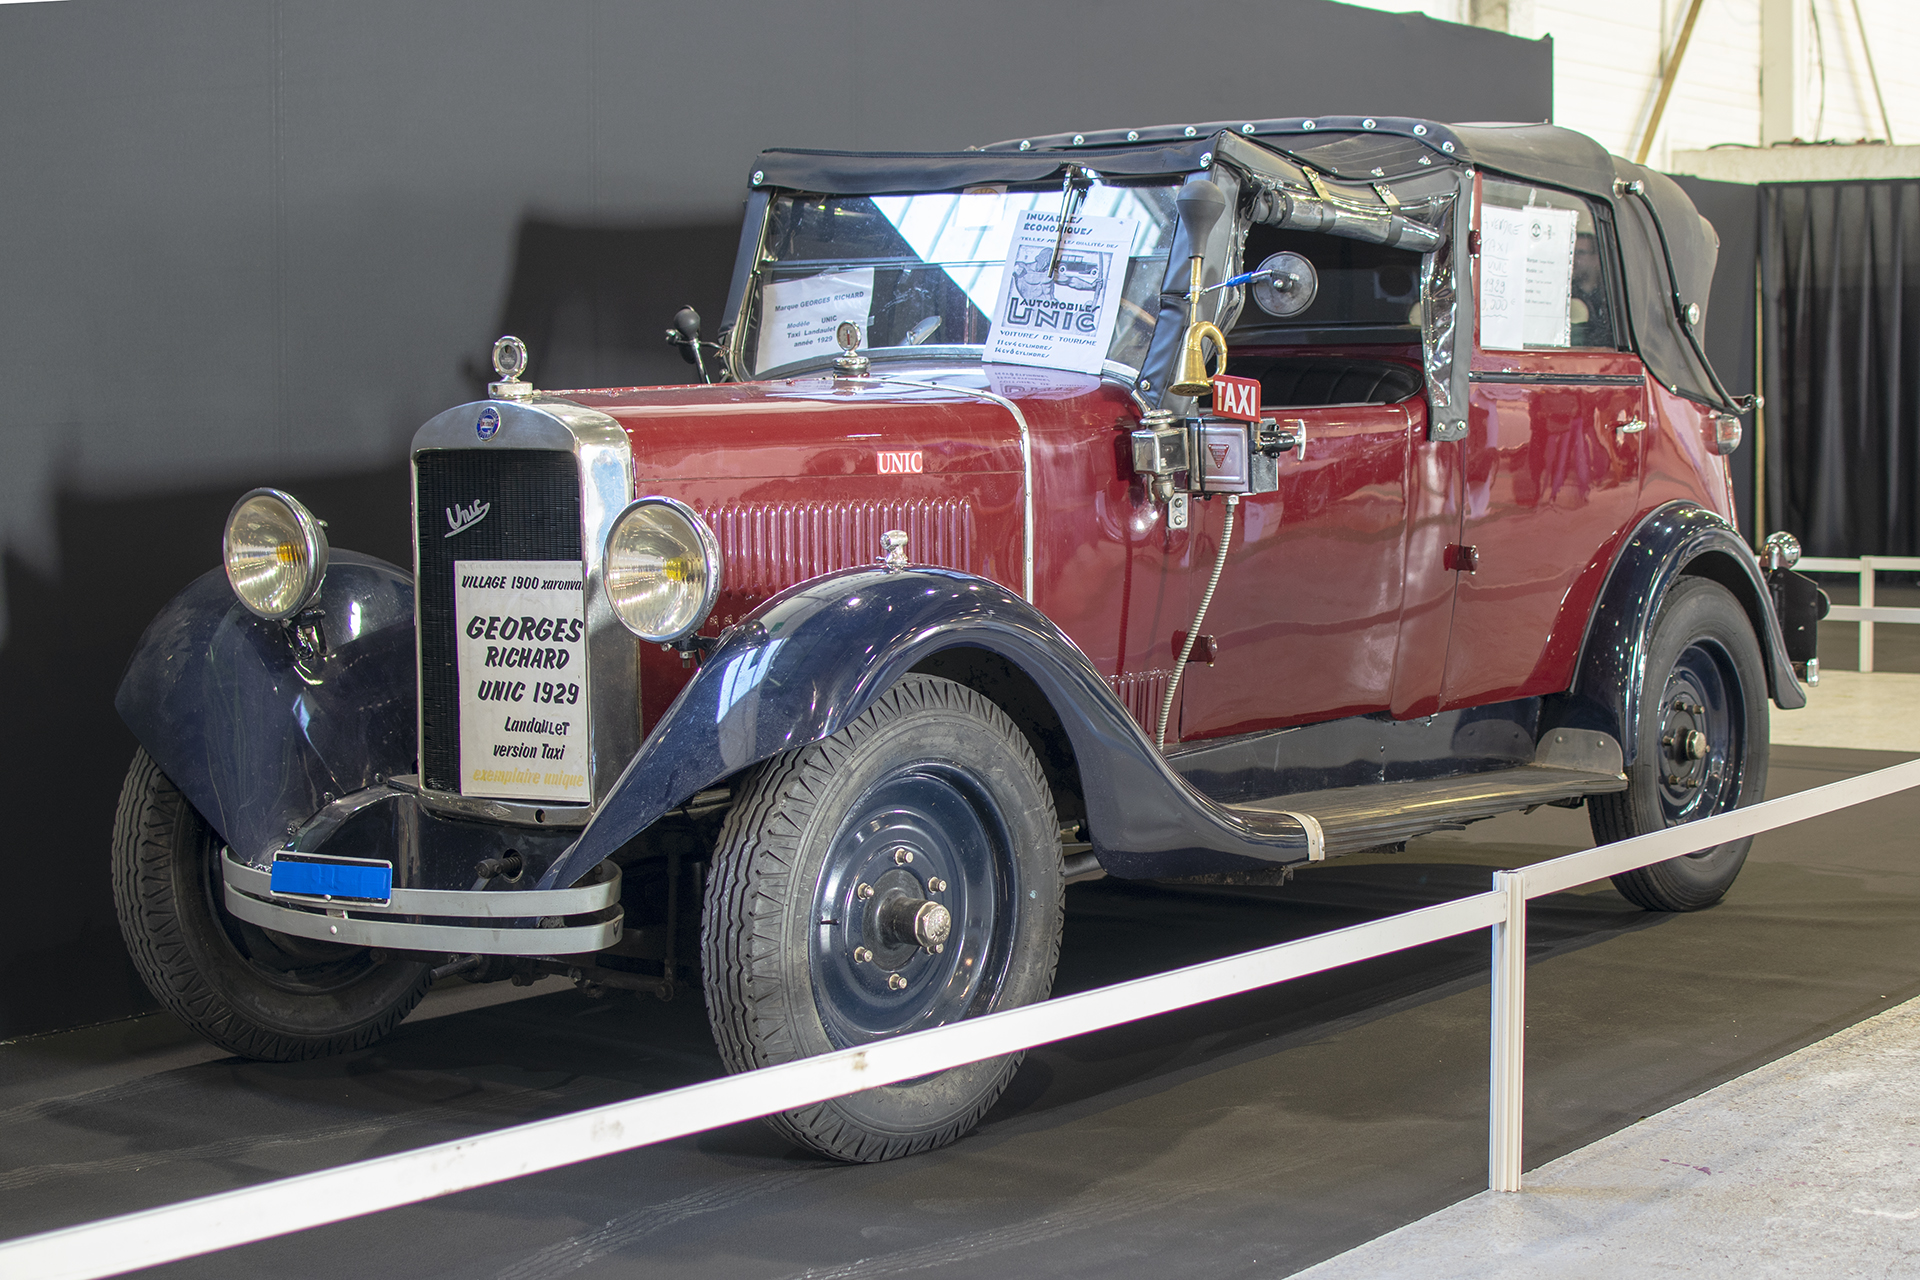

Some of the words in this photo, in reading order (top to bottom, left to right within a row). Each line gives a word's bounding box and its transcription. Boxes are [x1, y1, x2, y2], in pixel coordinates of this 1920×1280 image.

[775, 303, 799, 312] Marque
[800, 297, 831, 308] GEORGES
[834, 291, 864, 301] RICHARD
[1020, 299, 1100, 313] AUTOMOBILES
[786, 320, 810, 329] Modèle
[821, 315, 838, 324] UNIC
[1007, 297, 1096, 333] UNIC
[787, 331, 801, 339] Taxi
[803, 326, 836, 336] Landaulet
[794, 339, 814, 347] année
[818, 335, 833, 344] 1929
[1000, 330, 1039, 339] VOITURES
[1059, 336, 1098, 346] TOURISME
[1214, 380, 1256, 417] TAXI
[877, 452, 923, 473] UNIC
[445, 499, 490, 538] Unic
[461, 575, 507, 589] VILLAGE
[511, 576, 539, 590] 1900
[541, 579, 584, 591] xaronva
[465, 615, 584, 643] GEORGES
[484, 646, 570, 670] RICHARD
[477, 680, 526, 702] UNIC
[533, 681, 579, 705] 1929
[493, 743, 538, 759] version
[541, 743, 566, 760] Taxi
[472, 767, 541, 785] exemplaire
[543, 770, 584, 790] unique
